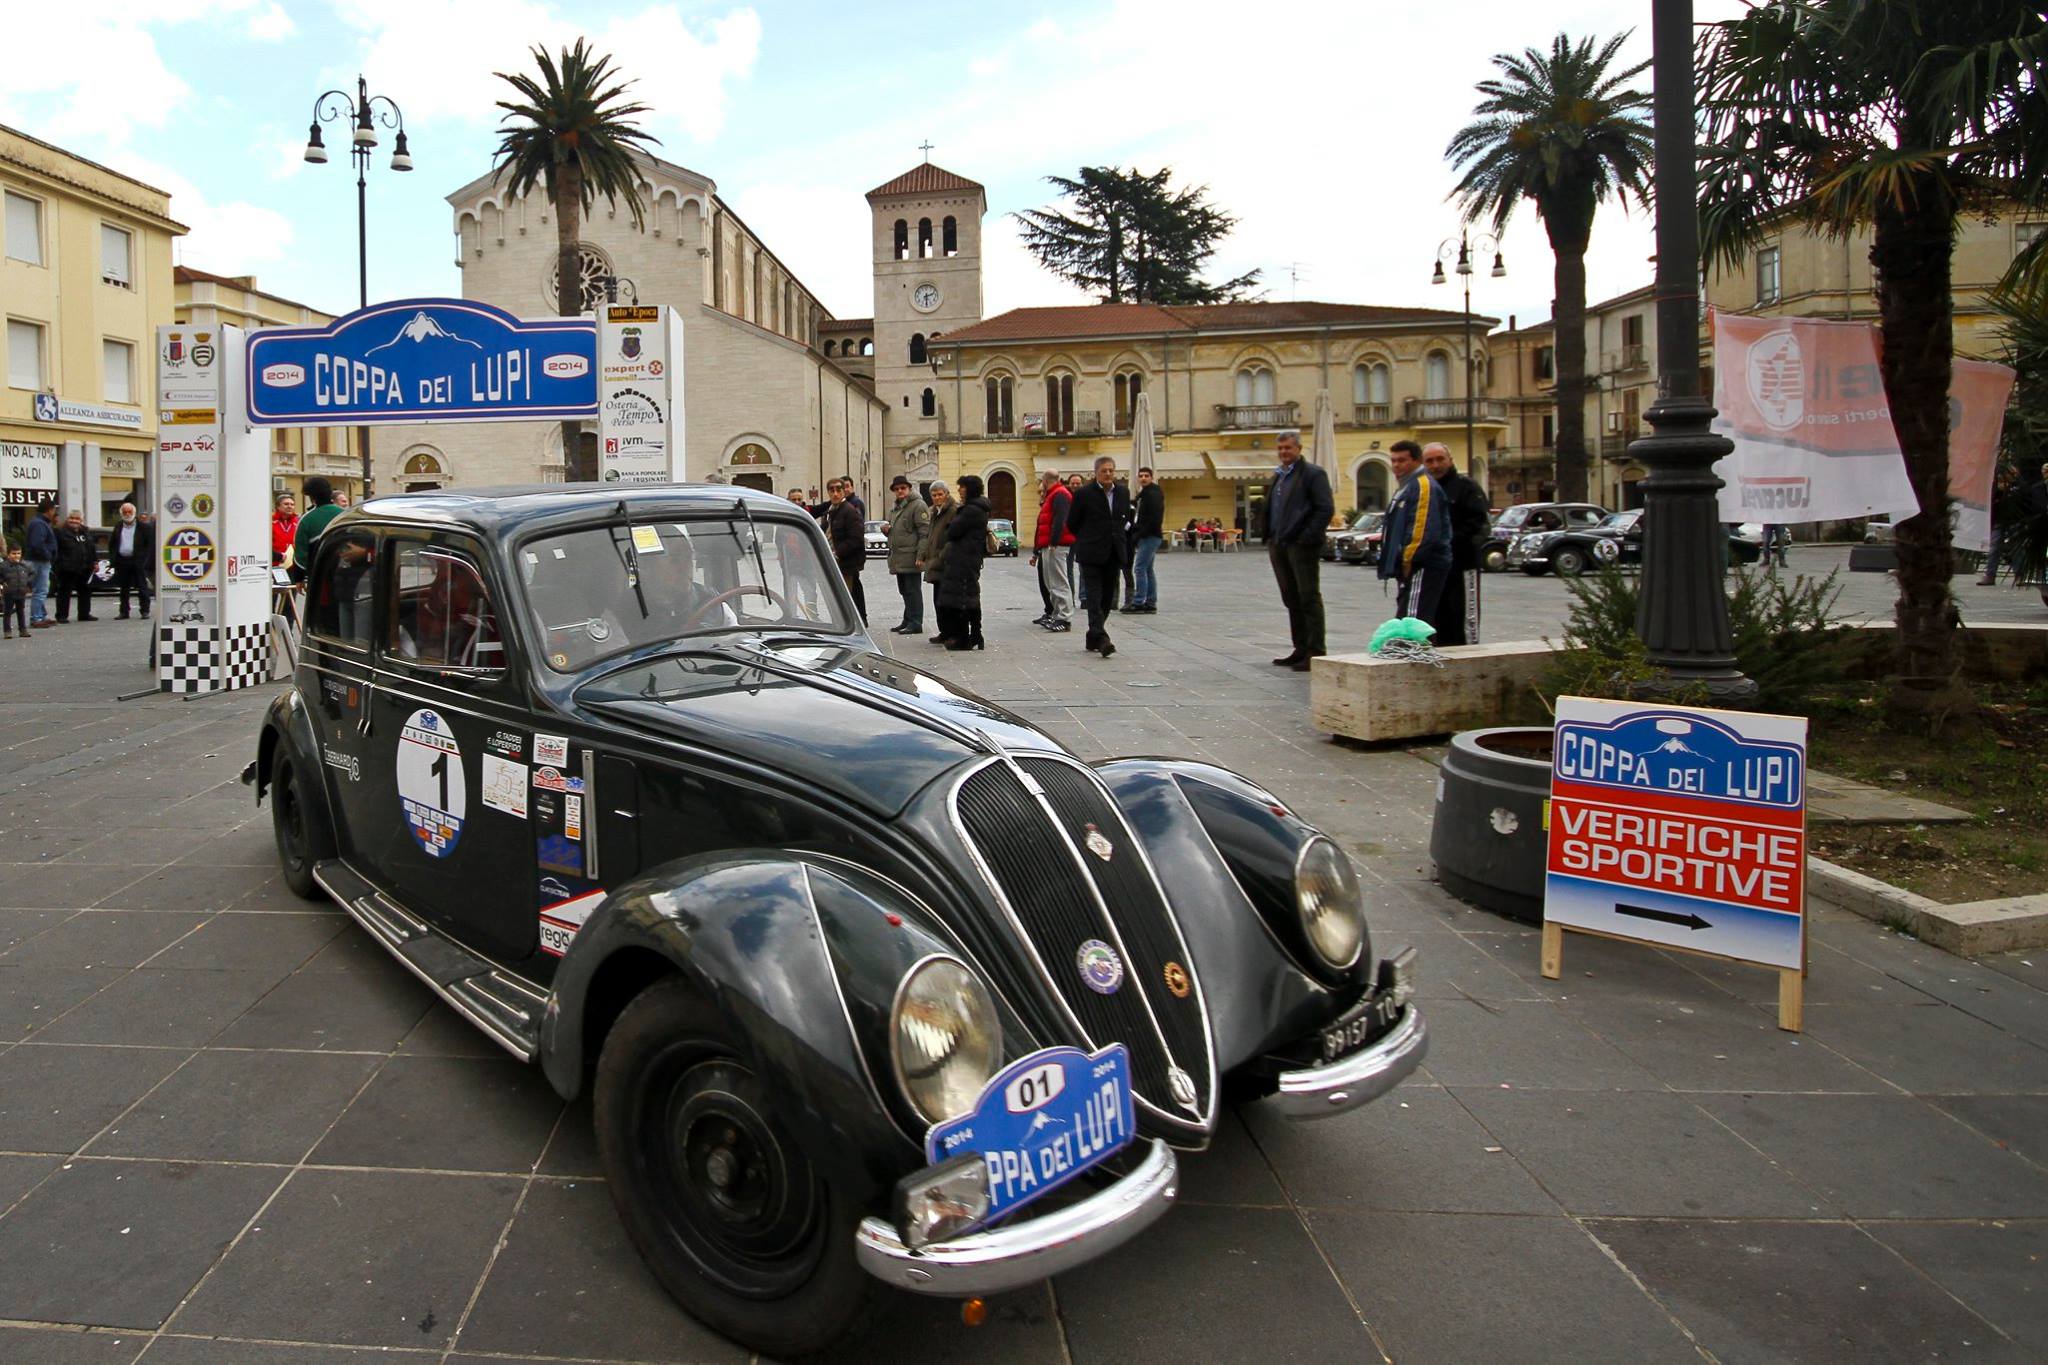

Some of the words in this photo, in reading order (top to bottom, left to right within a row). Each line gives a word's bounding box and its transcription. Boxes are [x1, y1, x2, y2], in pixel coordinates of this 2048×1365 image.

[547, 361, 584, 371] 2014
[604, 364, 645, 374] expert
[266, 370, 299, 381] 2014
[314, 352, 404, 406] COPPA
[419, 375, 452, 404] DEI
[471, 348, 530, 402] LUPI
[606, 400, 638, 410] Osteria
[60, 406, 95, 419] ALLEANZA
[619, 409, 655, 424] Tempo
[611, 418, 635, 427] Perso
[160, 441, 215, 452] SPARK
[622, 436, 644, 445] ivm
[22, 445, 34, 459] AL
[37, 446, 55, 460] 70%
[13, 466, 41, 480] SALDI
[0, 489, 56, 503] SISLEY
[175, 531, 199, 545] ACI
[1561, 731, 1651, 786] COPPA
[1668, 767, 1704, 792] DEI
[1726, 756, 1793, 803] LUPI
[431, 751, 448, 812] 1
[1559, 805, 1798, 869] VERIFICHE
[1562, 839, 1790, 904] SPORTIVE
[1093, 1059, 1116, 1078] 2014
[1020, 1070, 1050, 1107] 01
[944, 1127, 974, 1149] 2014
[984, 1149, 1037, 1206] PPA
[1040, 1131, 1074, 1180] DEI
[1075, 1077, 1124, 1156] LUPI
